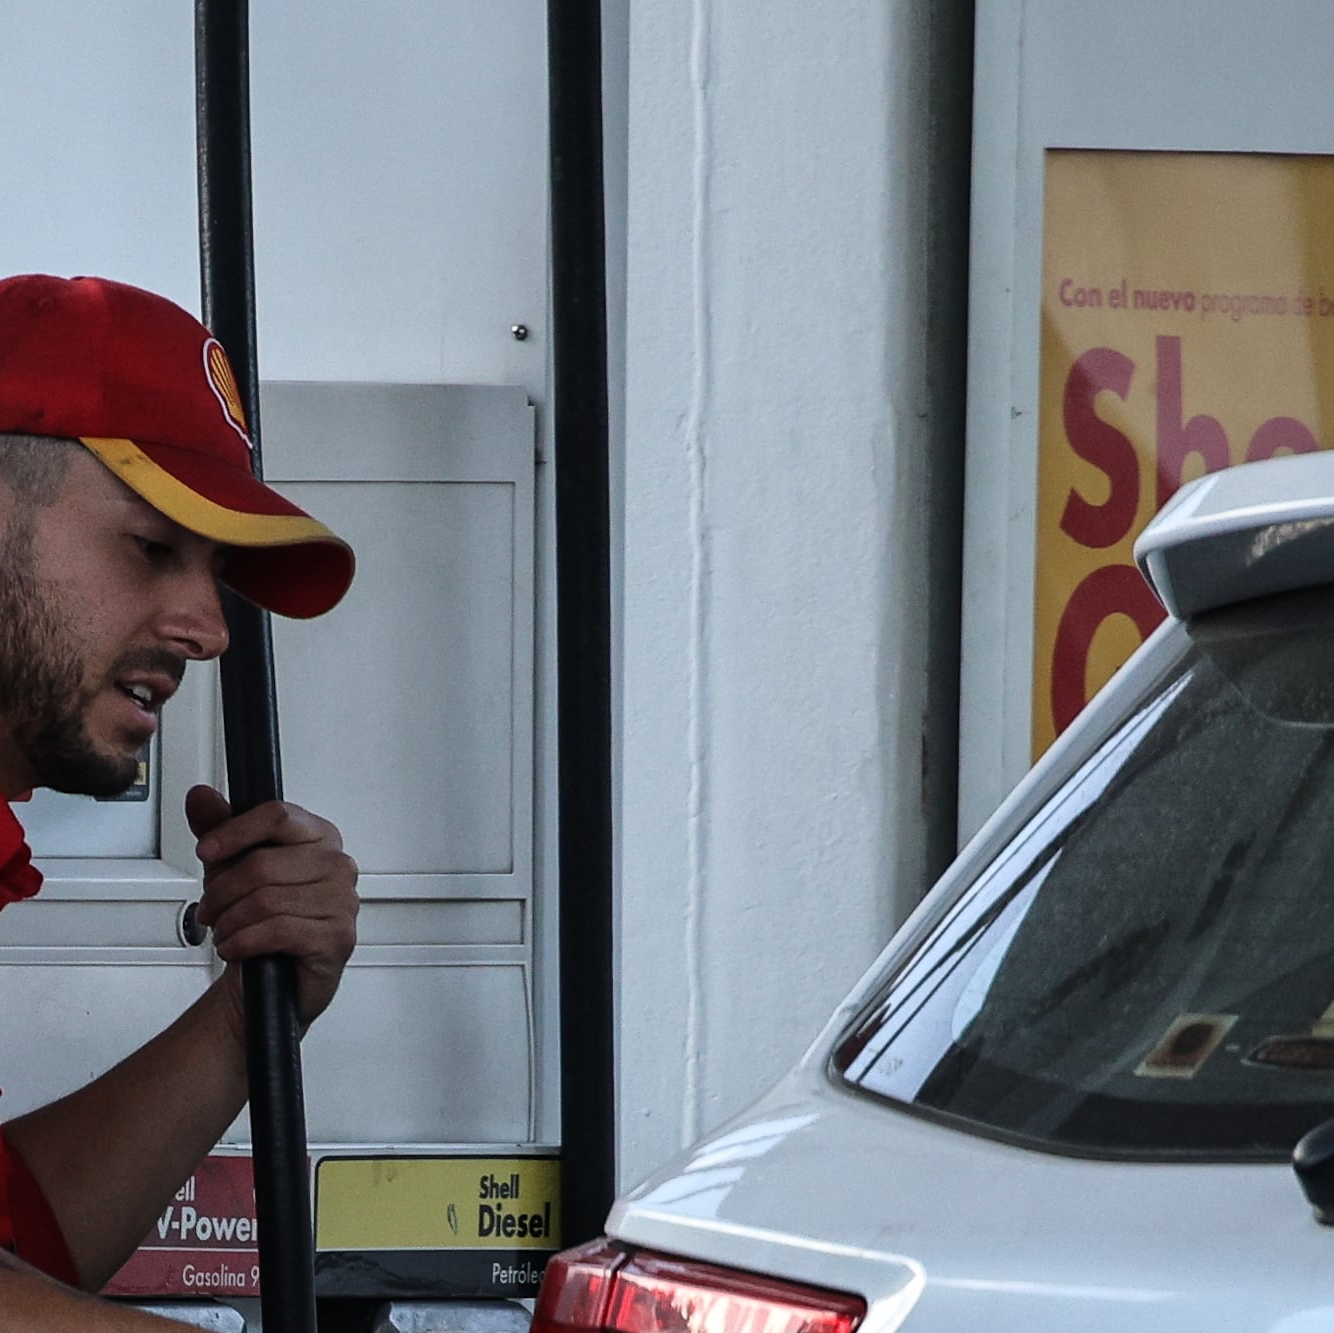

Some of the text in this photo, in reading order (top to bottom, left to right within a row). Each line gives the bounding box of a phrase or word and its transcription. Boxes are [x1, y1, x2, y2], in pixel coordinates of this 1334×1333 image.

[1059, 278, 1101, 308] Con
[1108, 279, 1128, 309] el
[1132, 289, 1195, 312] nuevo
[174, 1175, 196, 1202] ell
[479, 1173, 520, 1199] Shell
[478, 1201, 551, 1239] Diesel
[182, 1263, 246, 1287] Gasolina
